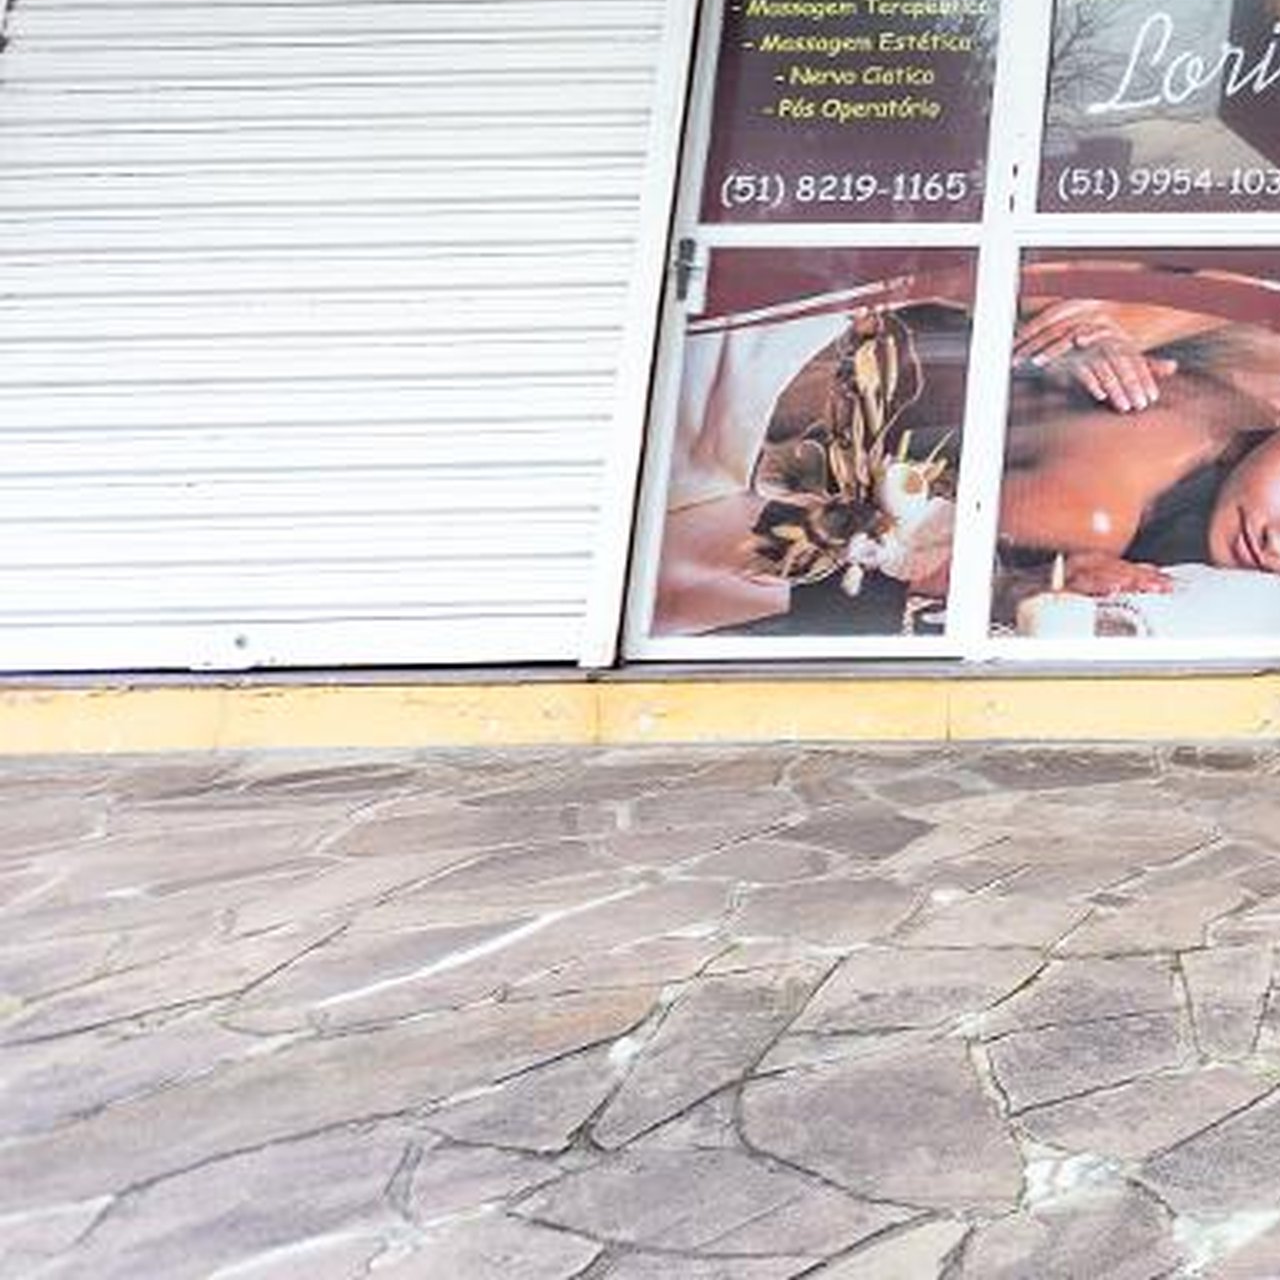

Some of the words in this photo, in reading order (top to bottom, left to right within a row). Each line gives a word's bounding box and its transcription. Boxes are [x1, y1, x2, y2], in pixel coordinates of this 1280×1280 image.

[759, 34, 872, 56] Massagem
[879, 31, 972, 51] Estética
[789, 65, 857, 84] Nervo
[778, 98, 816, 118] Pós
[821, 96, 942, 122] Operatório
[720, 174, 785, 208] (51)
[796, 173, 967, 202] 8219-1165
[1057, 167, 1120, 201] (51)
